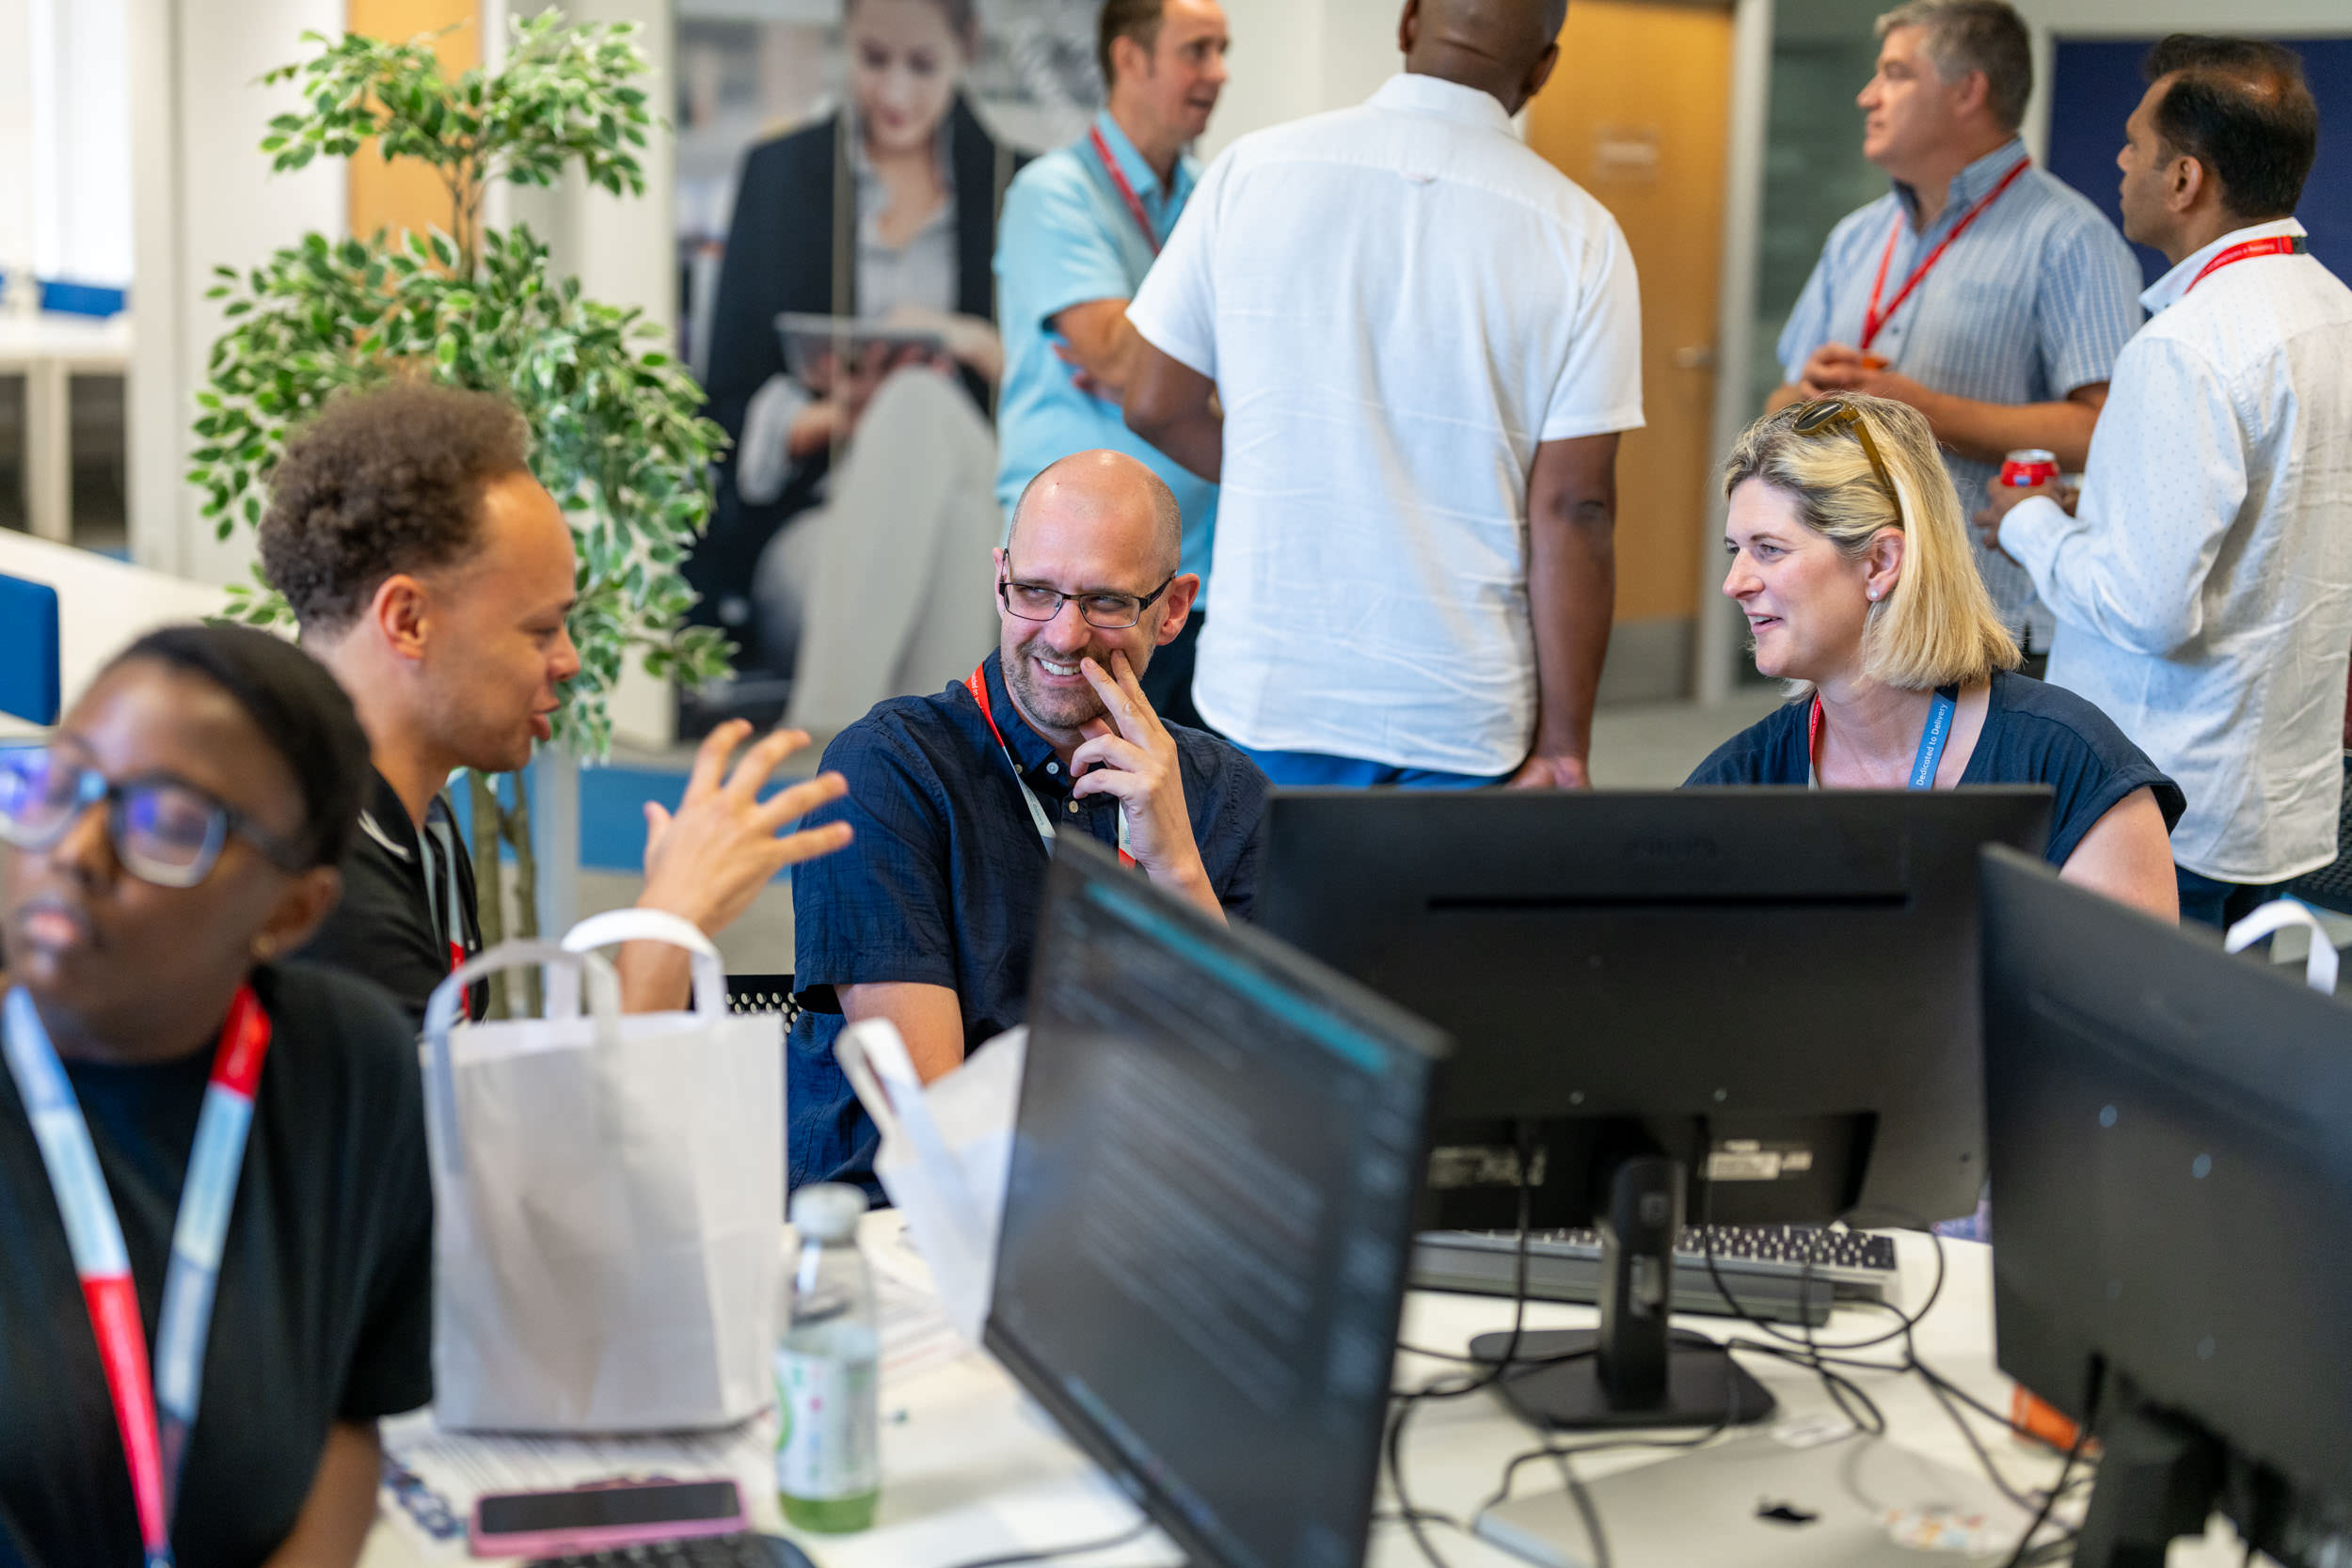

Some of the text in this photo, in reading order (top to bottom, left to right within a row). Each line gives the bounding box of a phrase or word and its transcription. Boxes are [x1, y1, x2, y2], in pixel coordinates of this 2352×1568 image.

[1916, 704, 1947, 786] Dedicated to Delivery
